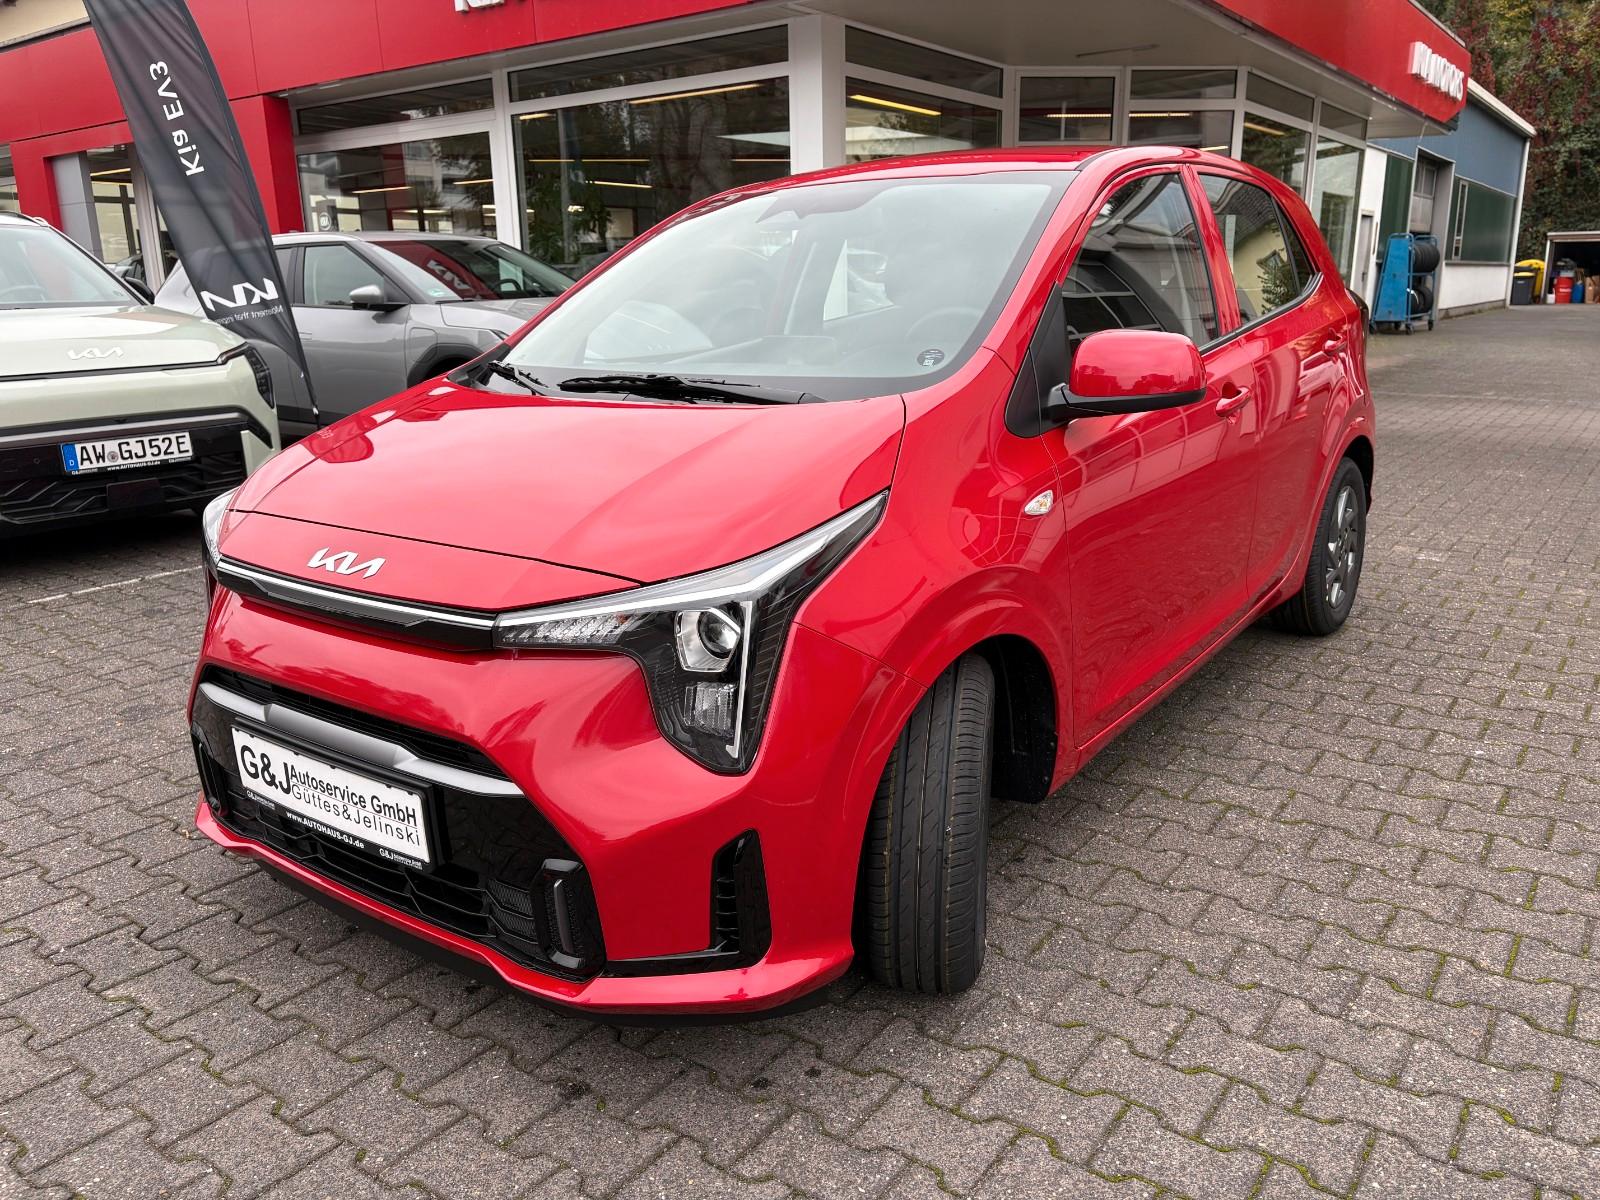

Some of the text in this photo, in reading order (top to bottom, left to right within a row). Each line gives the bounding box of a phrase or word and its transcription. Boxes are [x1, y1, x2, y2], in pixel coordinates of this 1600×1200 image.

[69, 459, 75, 467] D
[80, 443, 106, 466] AW
[240, 744, 291, 795] G&J
[290, 764, 367, 809] Autoservice
[370, 795, 418, 827] GmbH
[286, 811, 365, 849] www.AUTOHAUS-GJ.de
